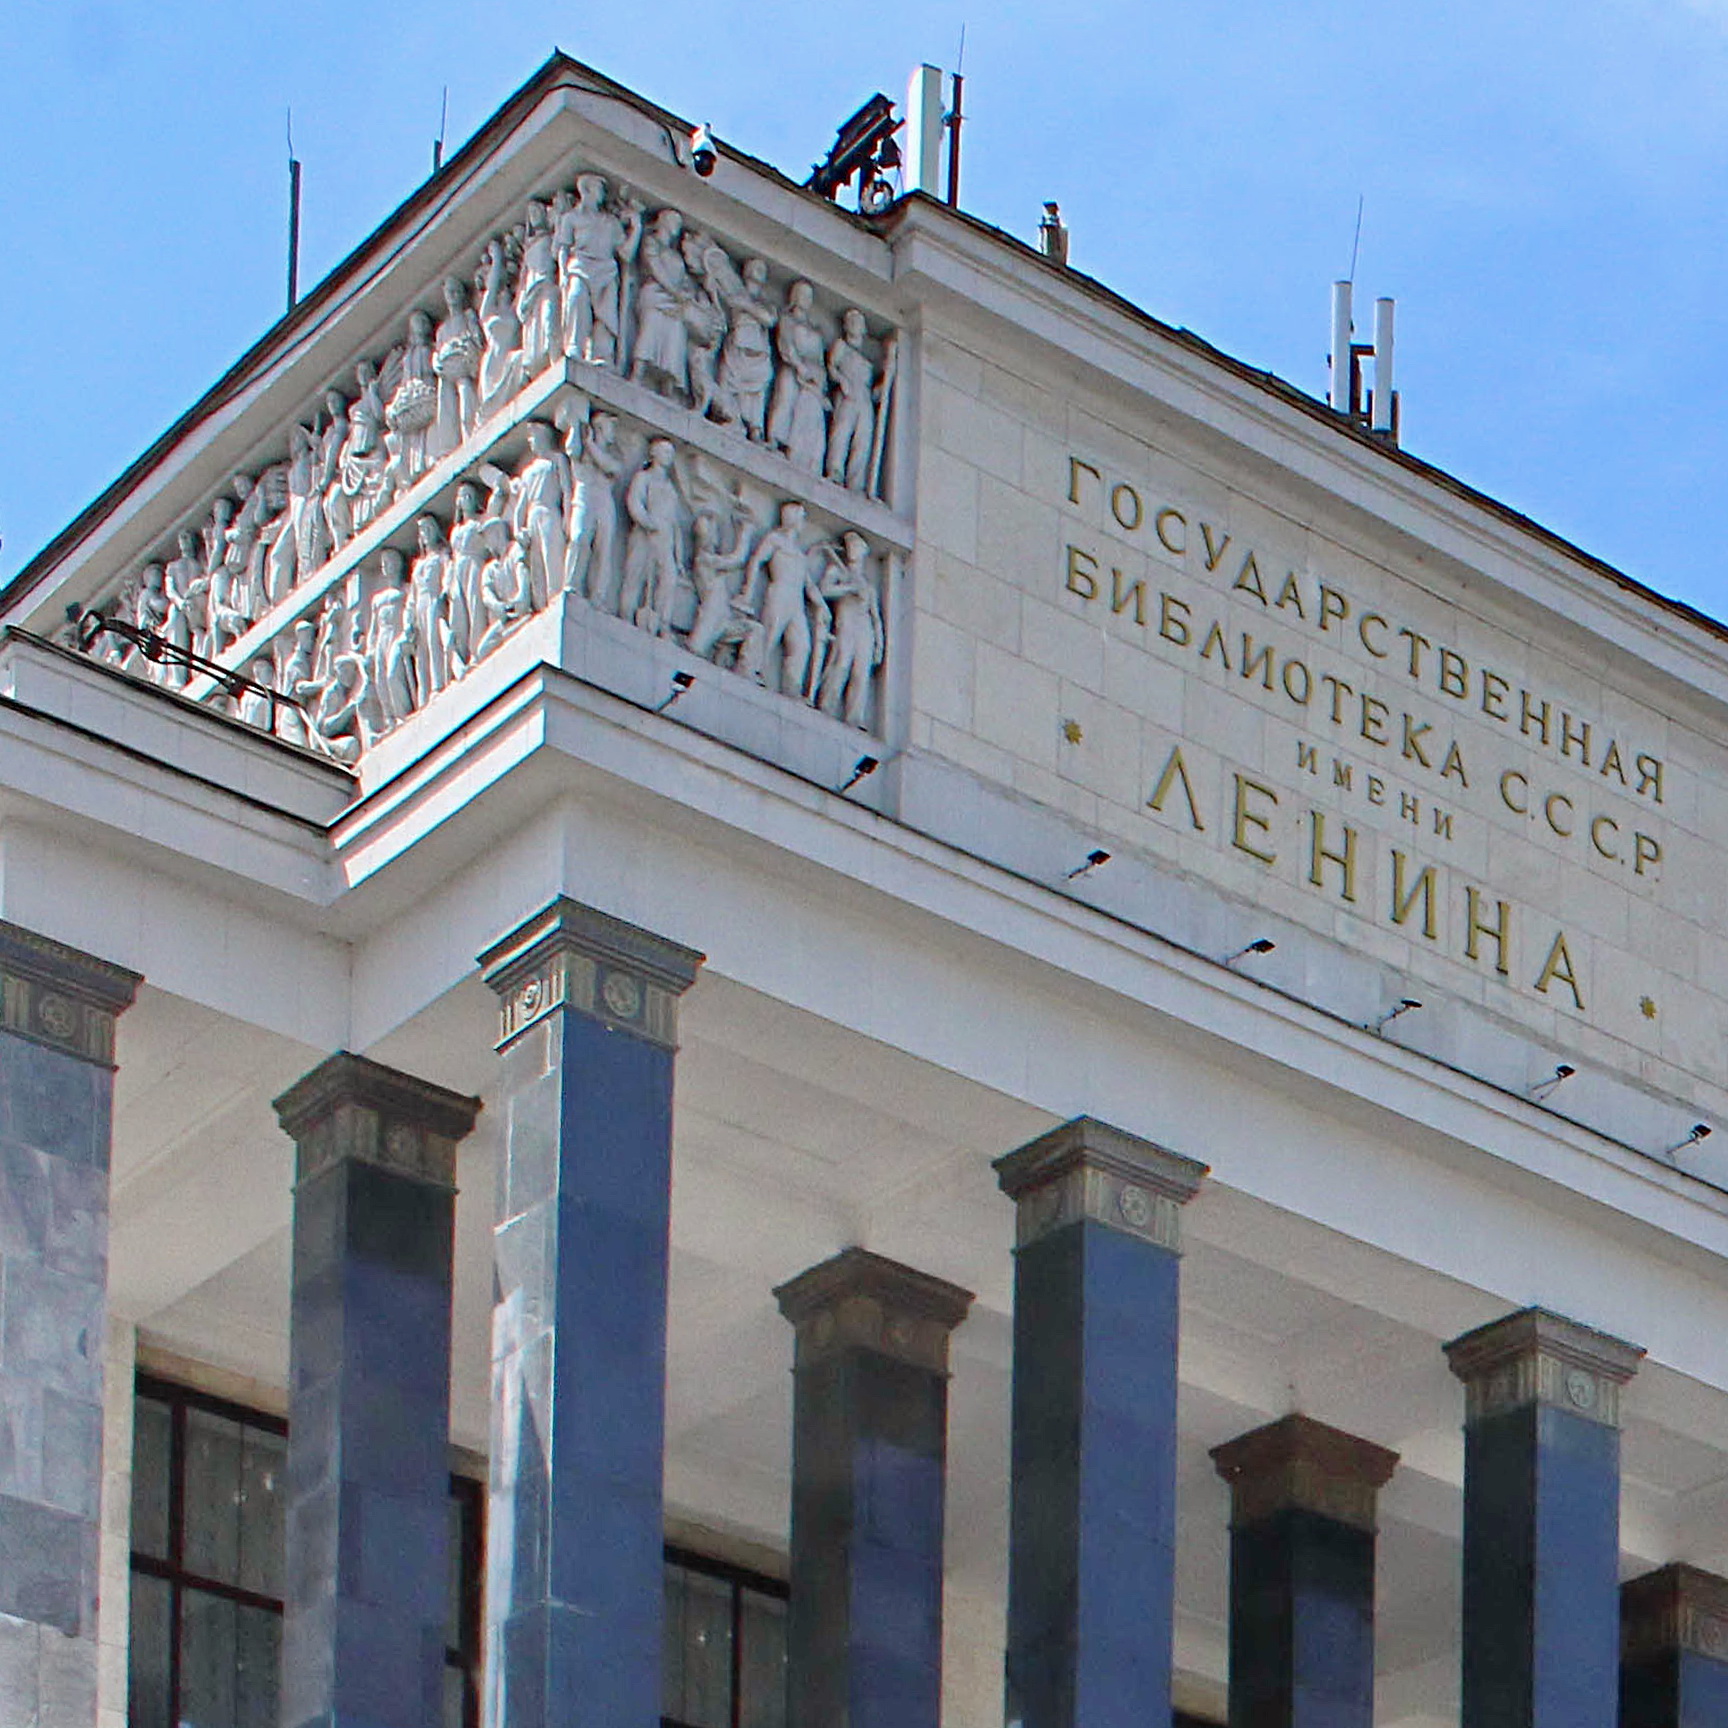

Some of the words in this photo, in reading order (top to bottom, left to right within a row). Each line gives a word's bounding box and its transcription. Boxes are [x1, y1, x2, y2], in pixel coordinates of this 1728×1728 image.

[1065, 543, 1470, 788] БИБЛИОТЕКА
[1066, 456, 1666, 804] ГОСУДАРСТВЕННАЯ
[1146, 745, 1587, 1010] ЛЕНИНА
[1297, 740, 1457, 842] ИМЕНИ
